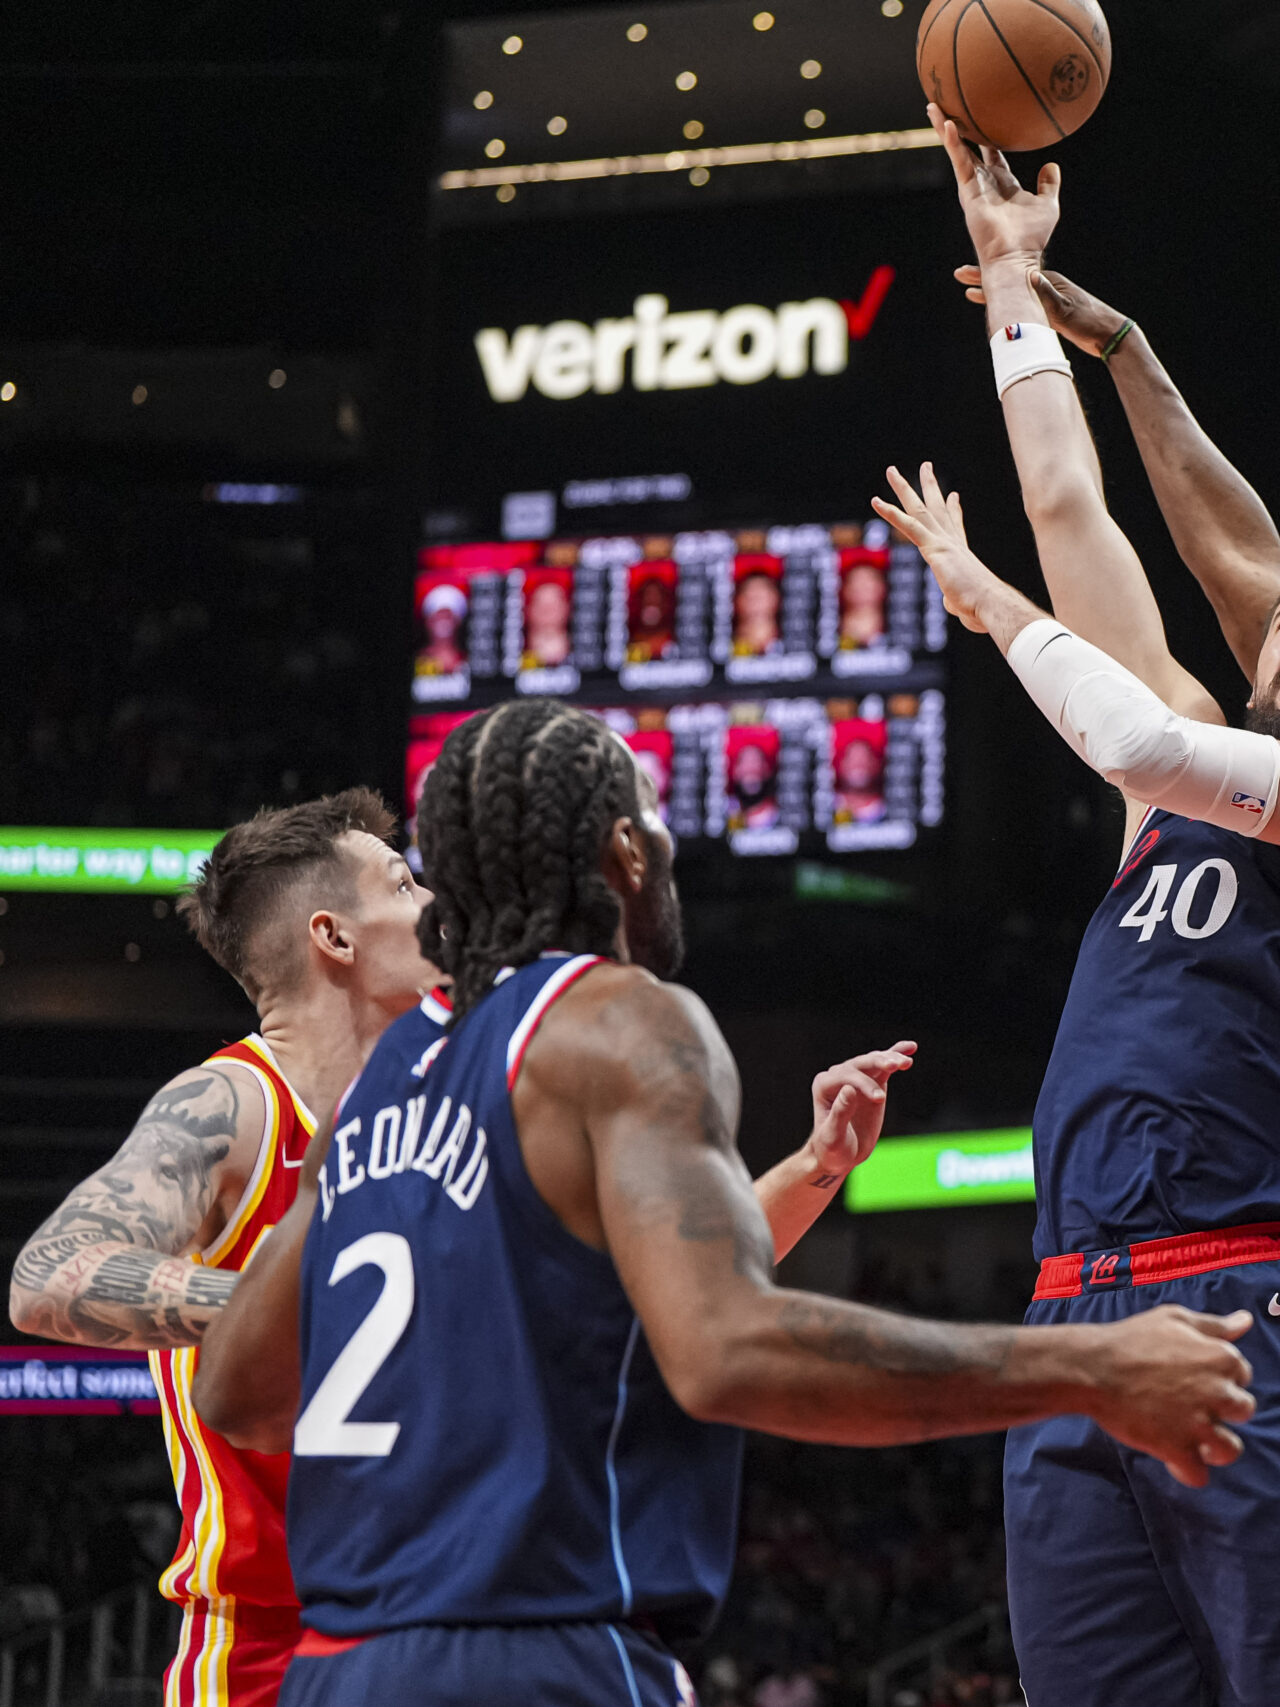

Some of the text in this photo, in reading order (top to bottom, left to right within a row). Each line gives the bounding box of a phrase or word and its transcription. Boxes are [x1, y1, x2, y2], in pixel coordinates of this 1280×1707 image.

[475, 293, 850, 402] verizon
[1119, 858, 1238, 943] 40
[318, 1094, 489, 1223] LEONARD
[293, 1232, 415, 1457] 2
